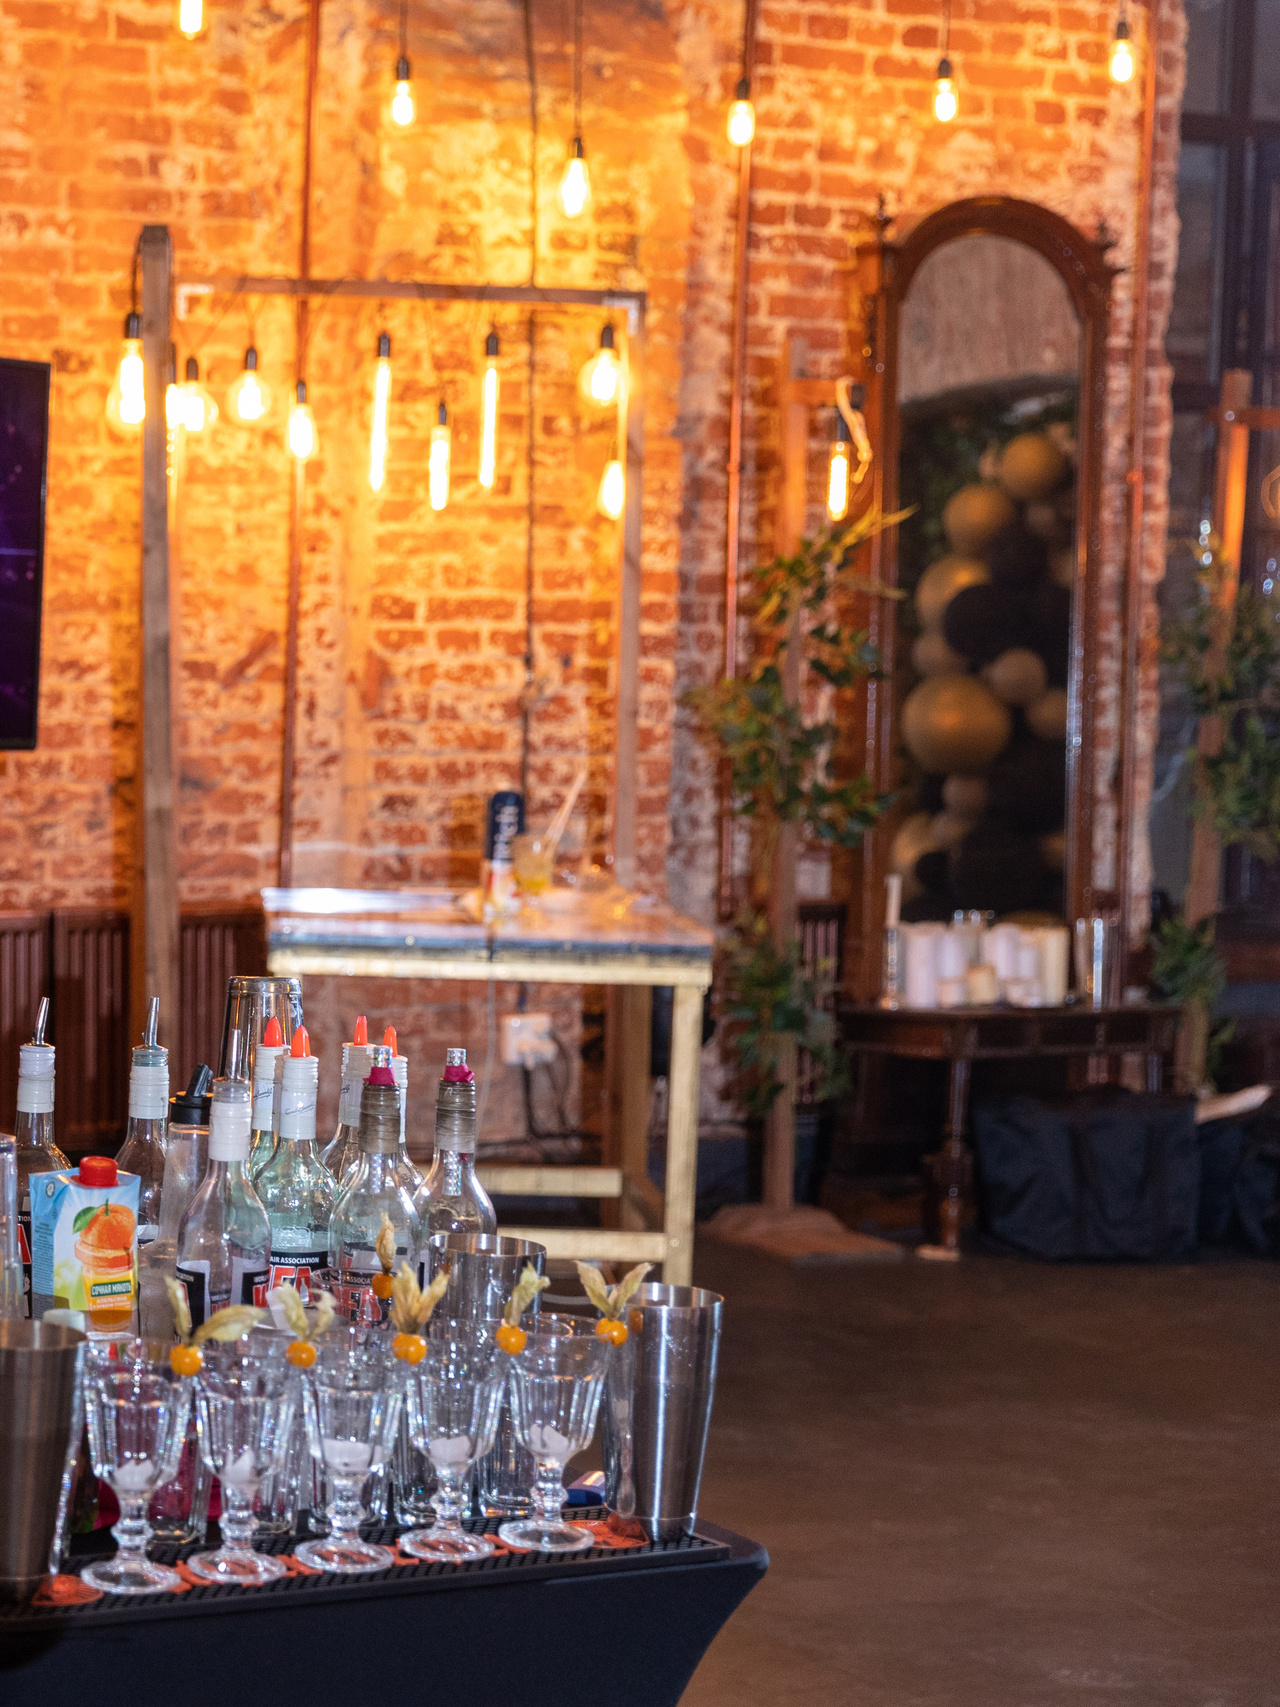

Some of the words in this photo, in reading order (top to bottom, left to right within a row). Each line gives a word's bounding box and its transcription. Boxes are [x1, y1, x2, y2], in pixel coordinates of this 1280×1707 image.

[280, 1256, 320, 1264] ASSOCIATION
[346, 1276, 372, 1284] ASSOCIA
[91, 1284, 112, 1295] СОЧНАЯ
[112, 1281, 132, 1293] МЯКОТЬ
